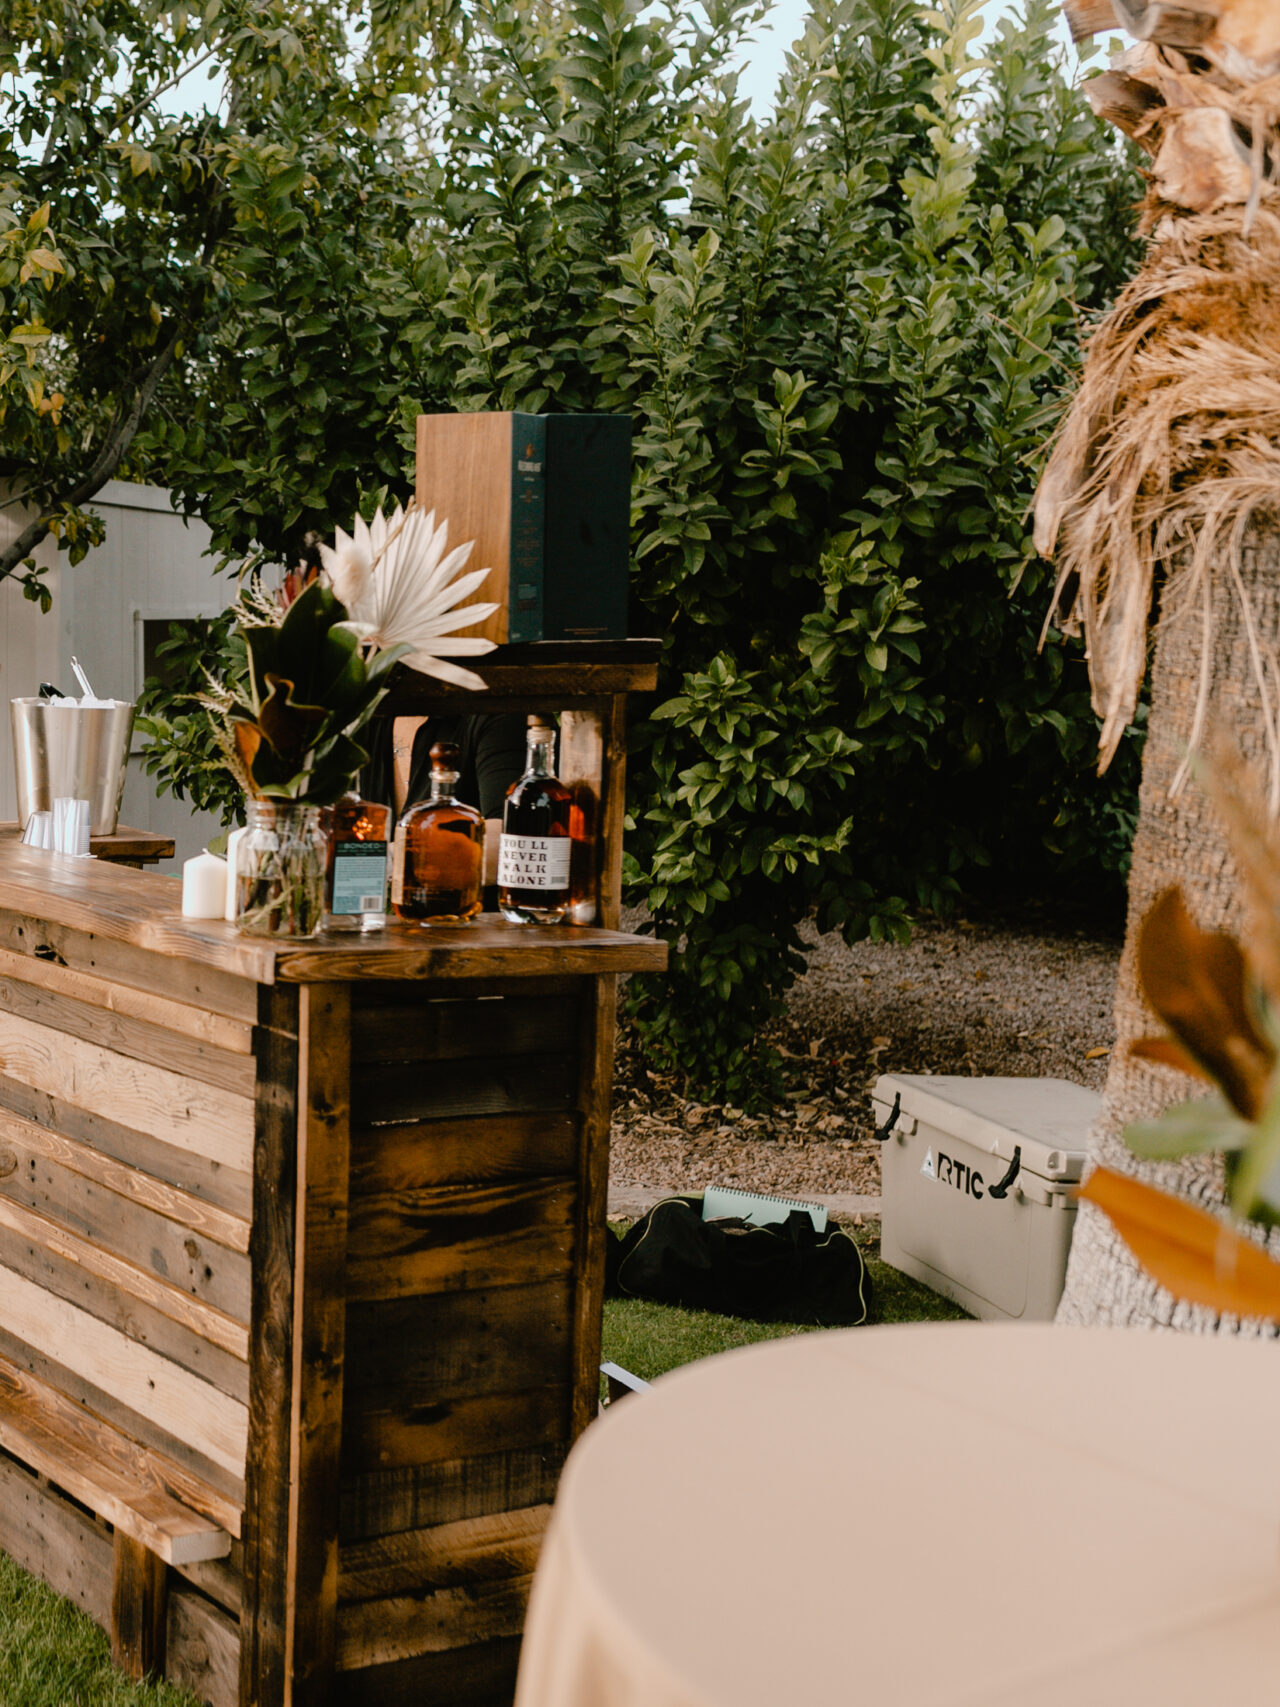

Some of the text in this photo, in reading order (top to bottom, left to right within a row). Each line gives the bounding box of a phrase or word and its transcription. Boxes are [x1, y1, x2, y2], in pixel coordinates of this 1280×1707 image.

[503, 850, 548, 862] NEVER
[503, 862, 547, 874] WALK
[503, 874, 546, 886] ALONE
